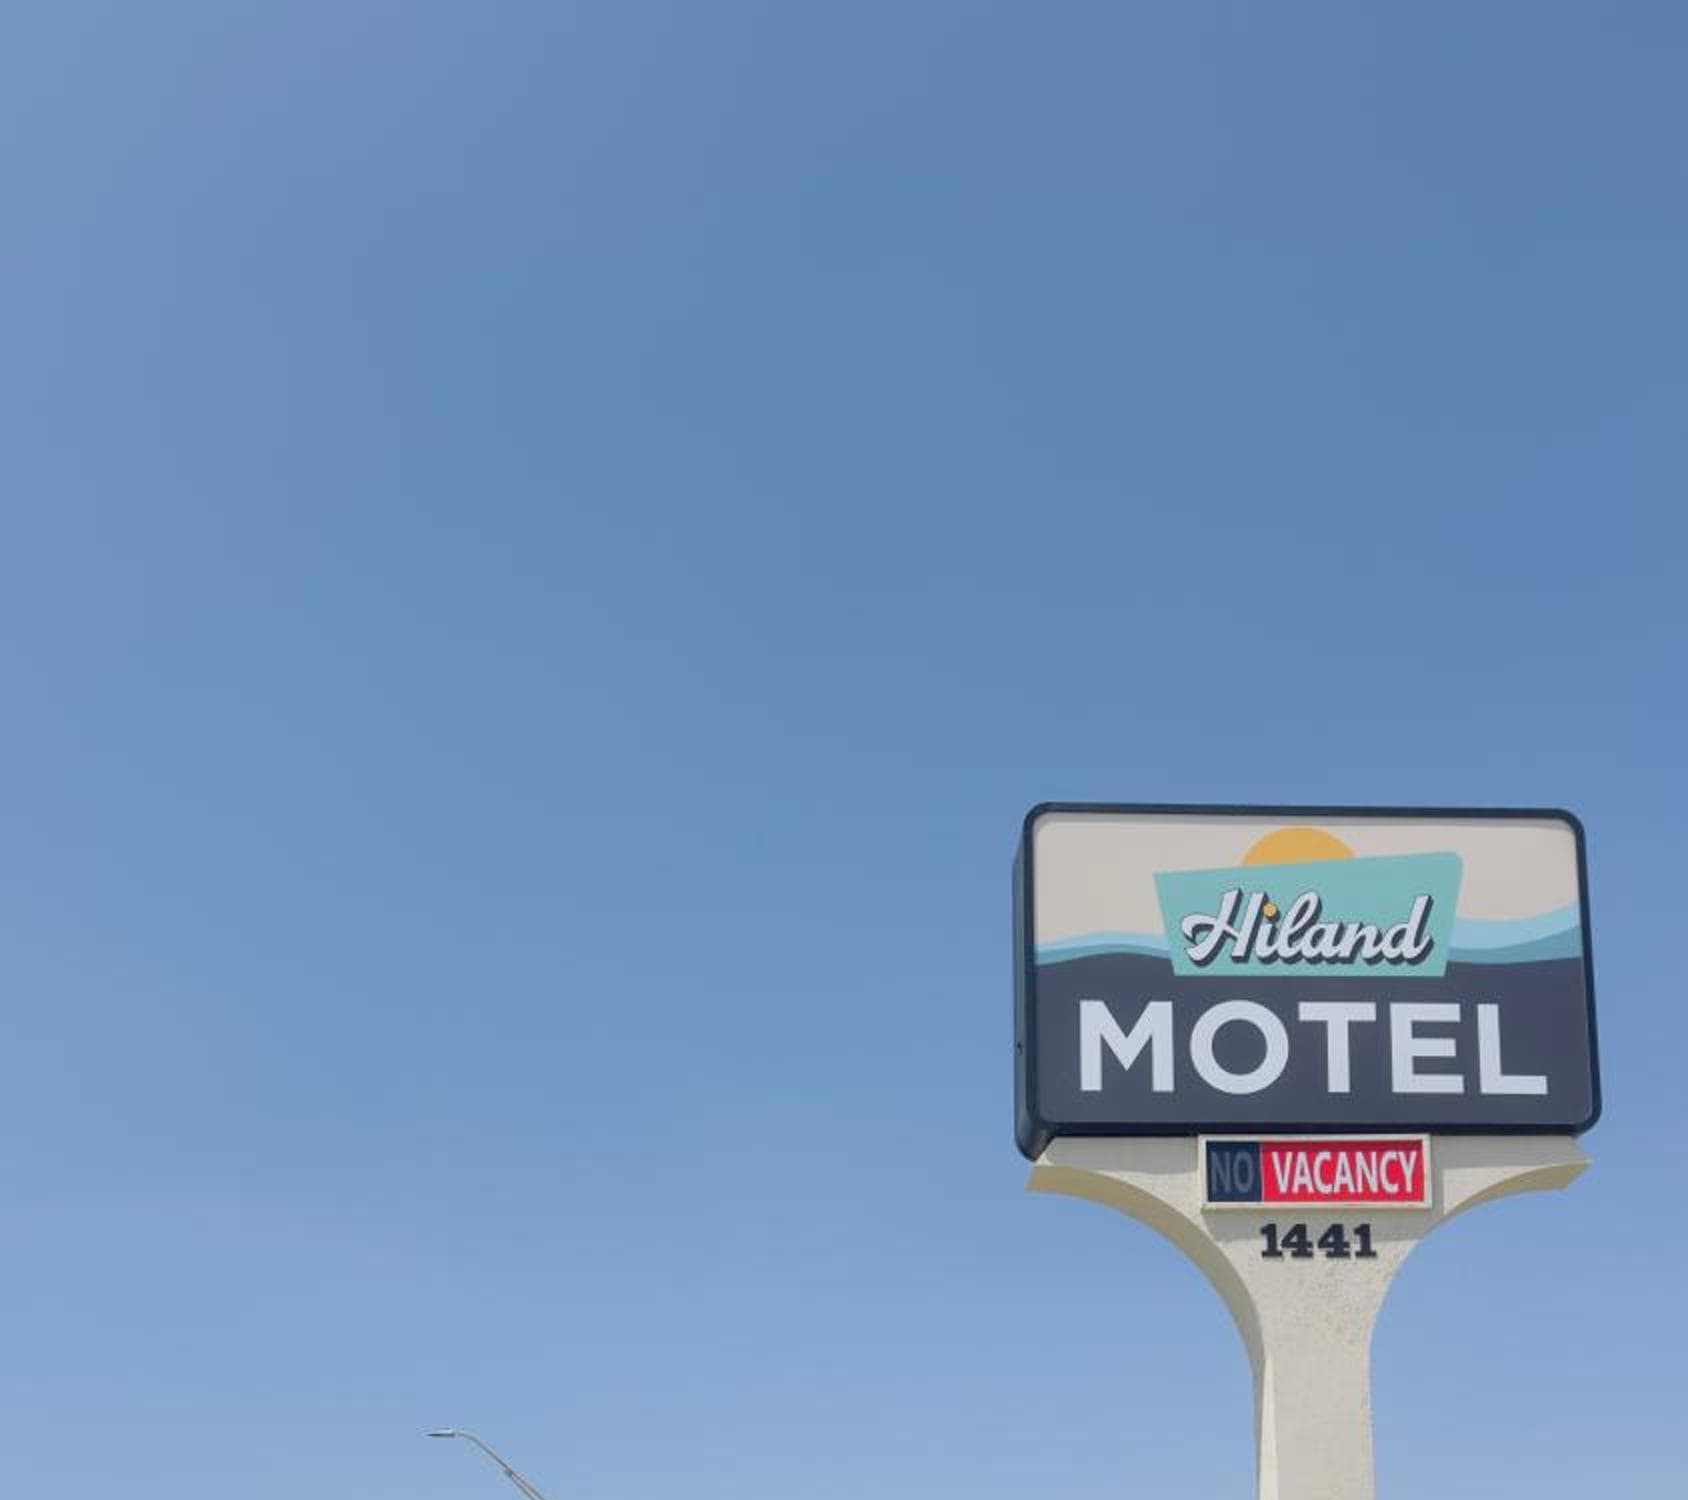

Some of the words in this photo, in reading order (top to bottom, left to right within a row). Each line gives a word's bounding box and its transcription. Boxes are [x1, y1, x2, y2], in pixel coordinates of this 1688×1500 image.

[1181, 888, 1433, 967] Hiland
[1080, 1000, 1548, 1094] MOTEL
[1209, 1152, 1254, 1193] NO
[1271, 1152, 1417, 1194] VACANCY
[1260, 1223, 1377, 1259] 1441
